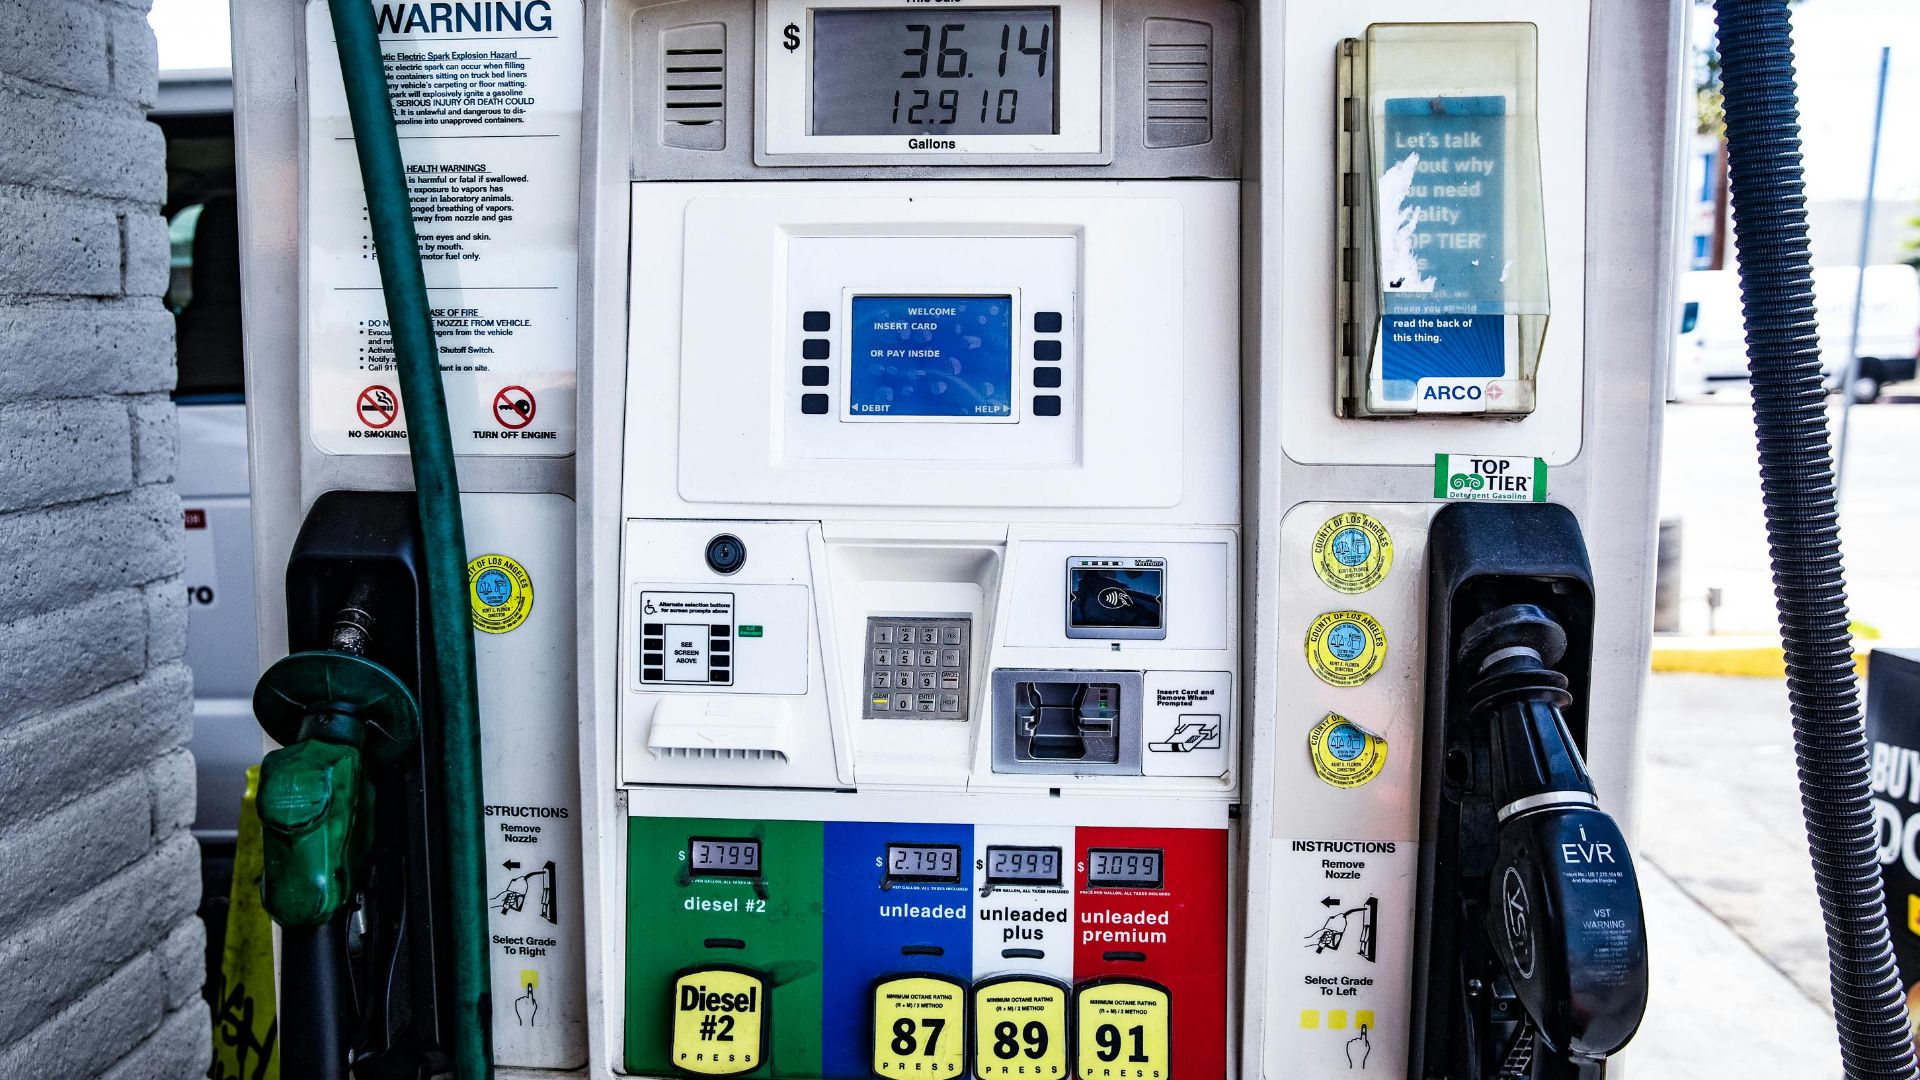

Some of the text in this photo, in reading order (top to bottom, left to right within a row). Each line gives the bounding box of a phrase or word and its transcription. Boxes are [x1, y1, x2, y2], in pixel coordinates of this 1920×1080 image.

[373, 0, 552, 33] WARNING
[784, 22, 800, 53] $
[398, 51, 517, 61] Electric Spark Explosion Hazard
[901, 24, 1049, 78] 36.14
[424, 63, 444, 72] spark
[504, 62, 524, 70] filling
[893, 89, 1018, 124] 12.910
[909, 138, 955, 149] Gallons
[1396, 132, 1481, 148] Let's talk
[1455, 157, 1493, 176] why
[1434, 181, 1480, 197] need
[463, 253, 480, 261] only.
[1393, 319, 1472, 327] read the back of
[1393, 334, 1442, 343] this thing.
[1424, 386, 1481, 400] ARCO
[1471, 459, 1509, 474] TOP
[1315, 524, 1332, 553] COUNTY
[1334, 518, 1343, 526] OF
[1363, 519, 1388, 547] ANGELES
[477, 560, 485, 568] OF
[504, 561, 528, 589] ANGELES
[1311, 616, 1331, 642] COUNTY
[1362, 618, 1383, 647] ANGELES
[485, 805, 568, 818] STRUCTIONS
[500, 824, 541, 833] Remove
[504, 834, 538, 843] Nozzle
[1292, 841, 1395, 853] INSTRUCTIONS
[1562, 844, 1615, 863] EVR
[700, 845, 754, 865] 3.799
[895, 851, 952, 870] 2.799
[976, 853, 1053, 873] $ 2.999
[1077, 856, 1153, 875] $ 3.099
[1322, 859, 1365, 869] Remove
[1325, 870, 1360, 880] Nozzle
[684, 897, 766, 912] diesel #2
[880, 903, 966, 919] unleaded
[980, 907, 1067, 922] unleaded
[1081, 910, 1168, 925] unleaded
[1594, 909, 1611, 917] VST
[1583, 920, 1625, 929] WARNING
[492, 936, 556, 946] Select Grade
[1003, 925, 1043, 942] plus
[1083, 928, 1166, 944] premium
[504, 946, 546, 957] To Right
[1304, 976, 1373, 986] Select Grade
[680, 985, 756, 1012] Diesel
[1320, 987, 1357, 996] To Left
[700, 1015, 734, 1042] #2
[891, 1018, 945, 1056] 87
[993, 1021, 1048, 1060] 89
[1096, 1024, 1148, 1062] 91
[682, 1053, 750, 1062] PRESS
[883, 1062, 954, 1071] PRESS
[986, 1066, 1057, 1074] PRESS
[1088, 1069, 1159, 1077] PRESS
